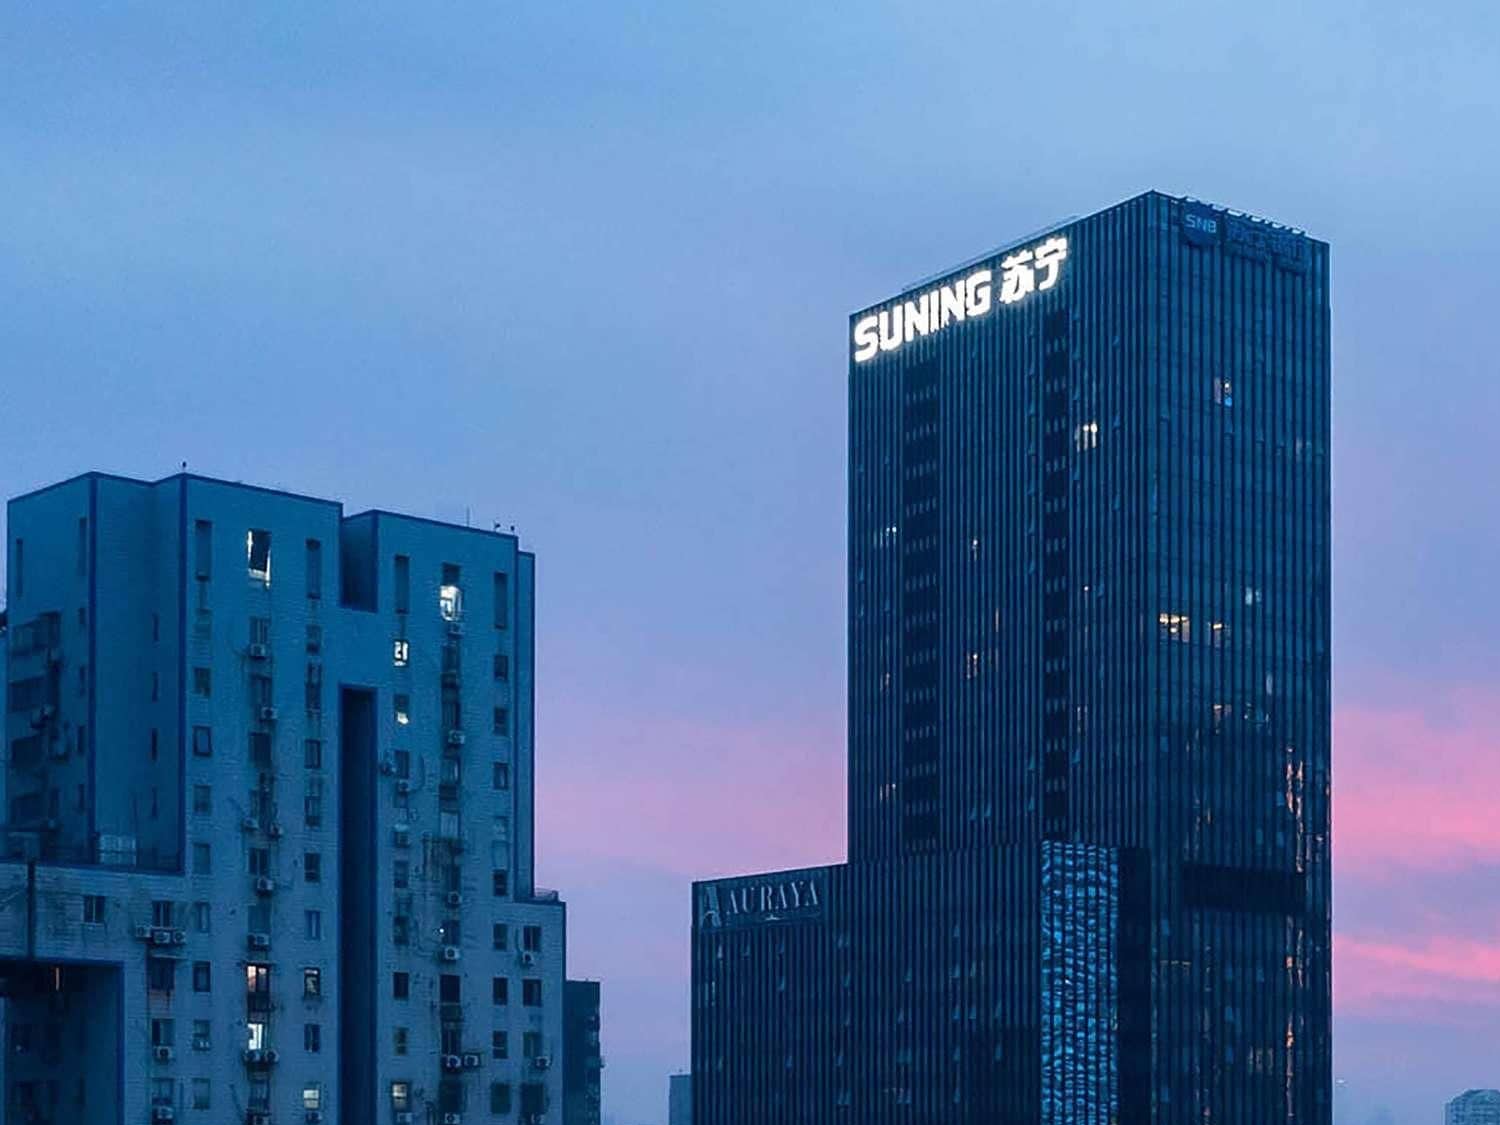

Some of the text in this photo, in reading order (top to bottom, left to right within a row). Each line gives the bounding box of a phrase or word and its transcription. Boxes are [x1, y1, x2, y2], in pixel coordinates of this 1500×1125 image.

[853, 236, 1067, 362] SUNING 苏宁
[726, 880, 819, 915] AURAYA
